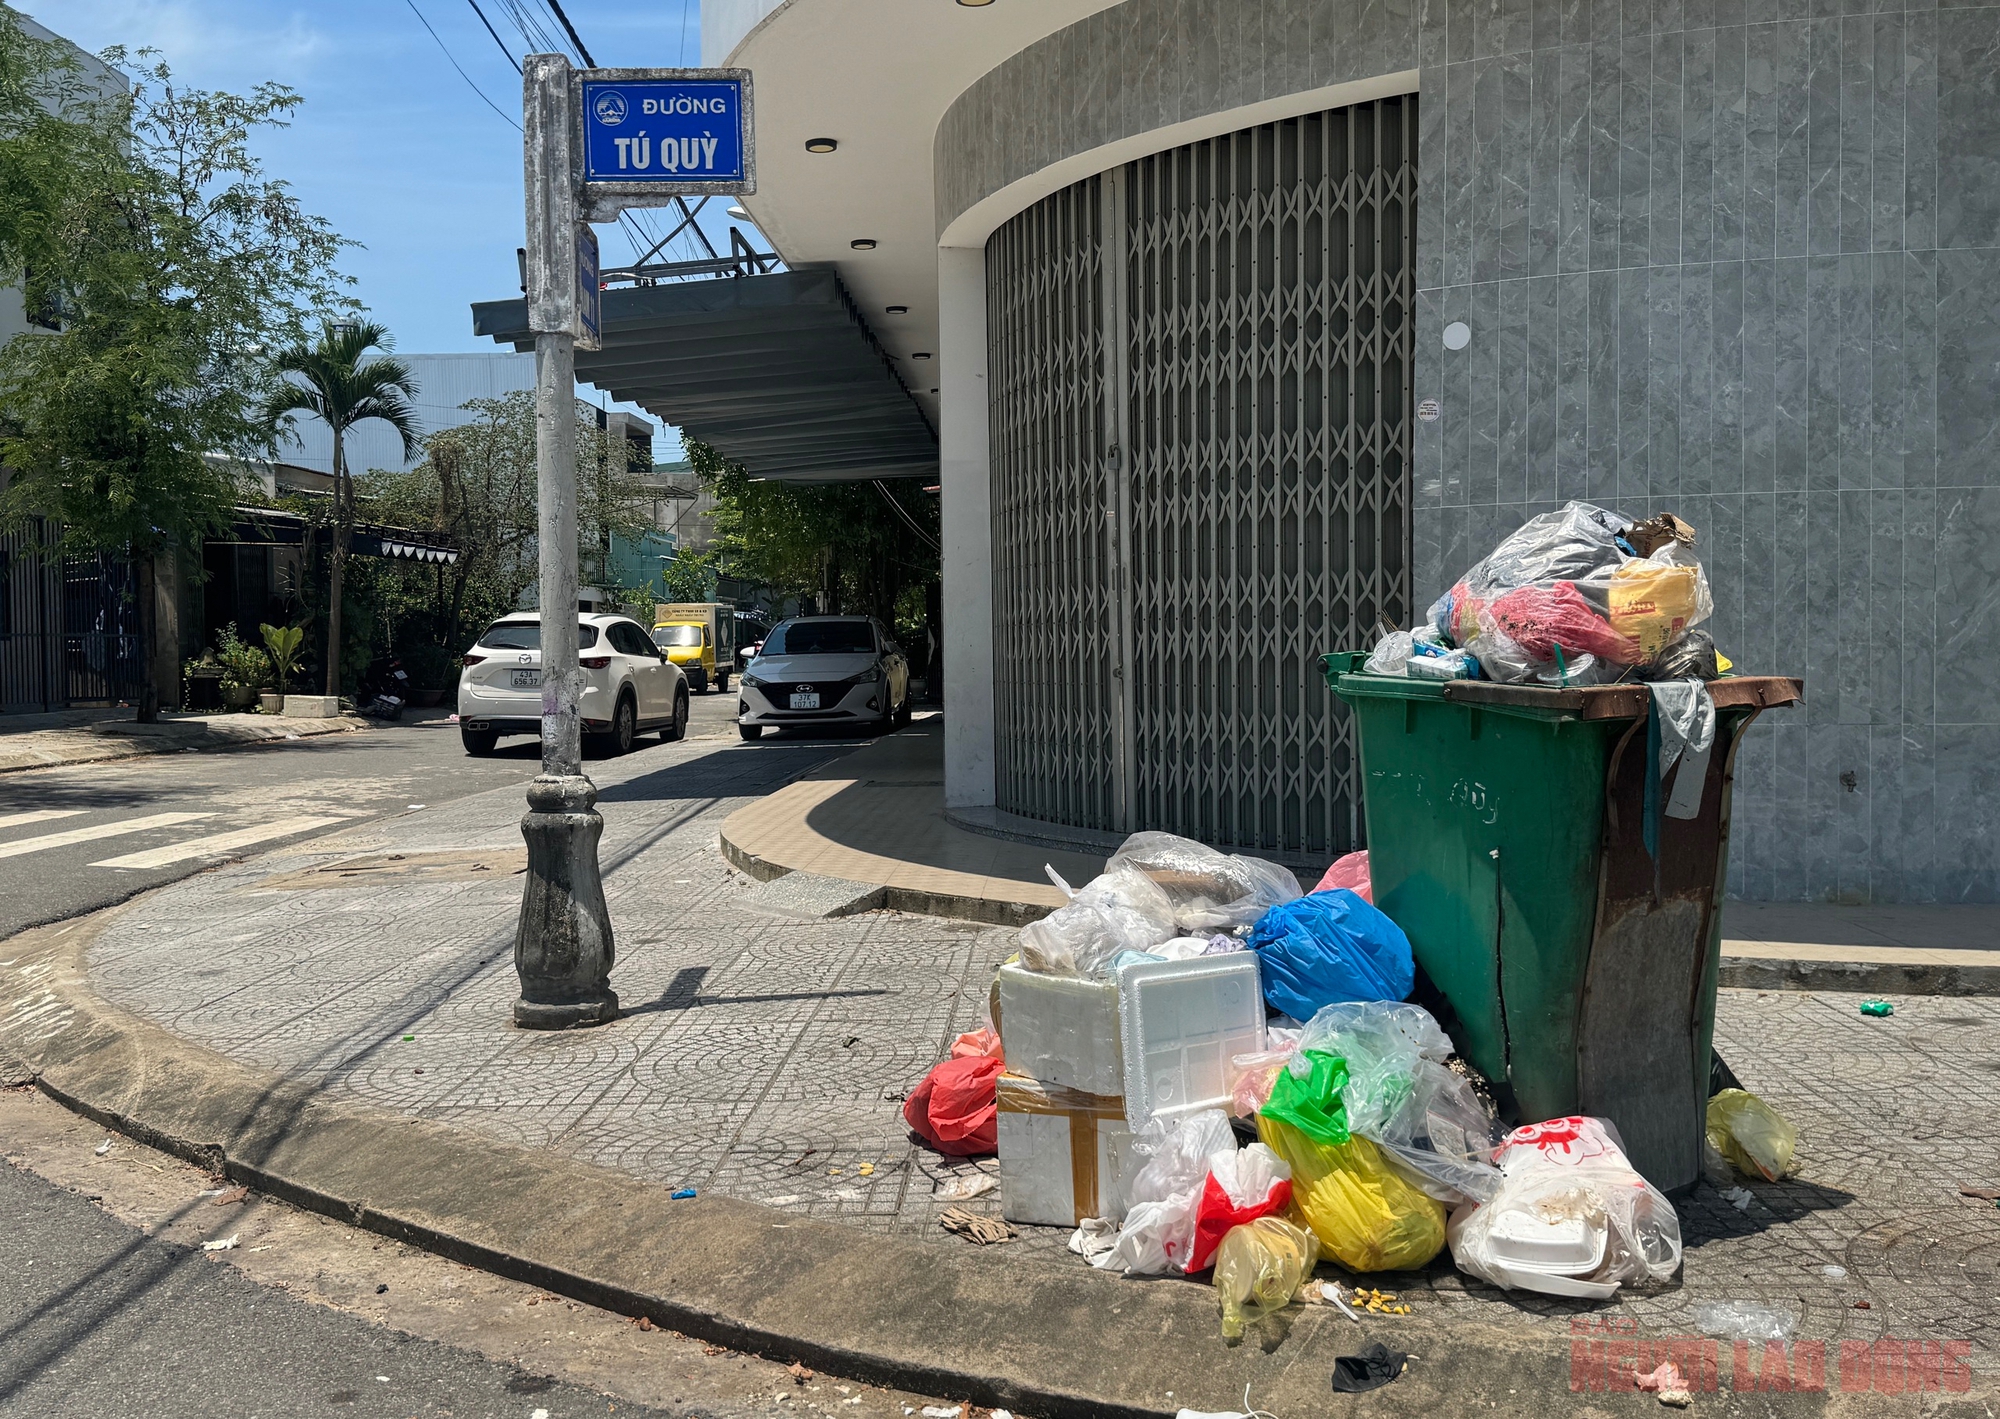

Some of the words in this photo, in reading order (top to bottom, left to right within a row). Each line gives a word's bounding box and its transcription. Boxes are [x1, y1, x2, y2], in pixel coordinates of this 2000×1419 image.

[642, 93, 726, 115] ĐƯỜNG
[614, 130, 650, 170] TÚ
[660, 131, 718, 173] QUỲ
[519, 670, 533, 678] 43A
[513, 678, 538, 686] 656.37
